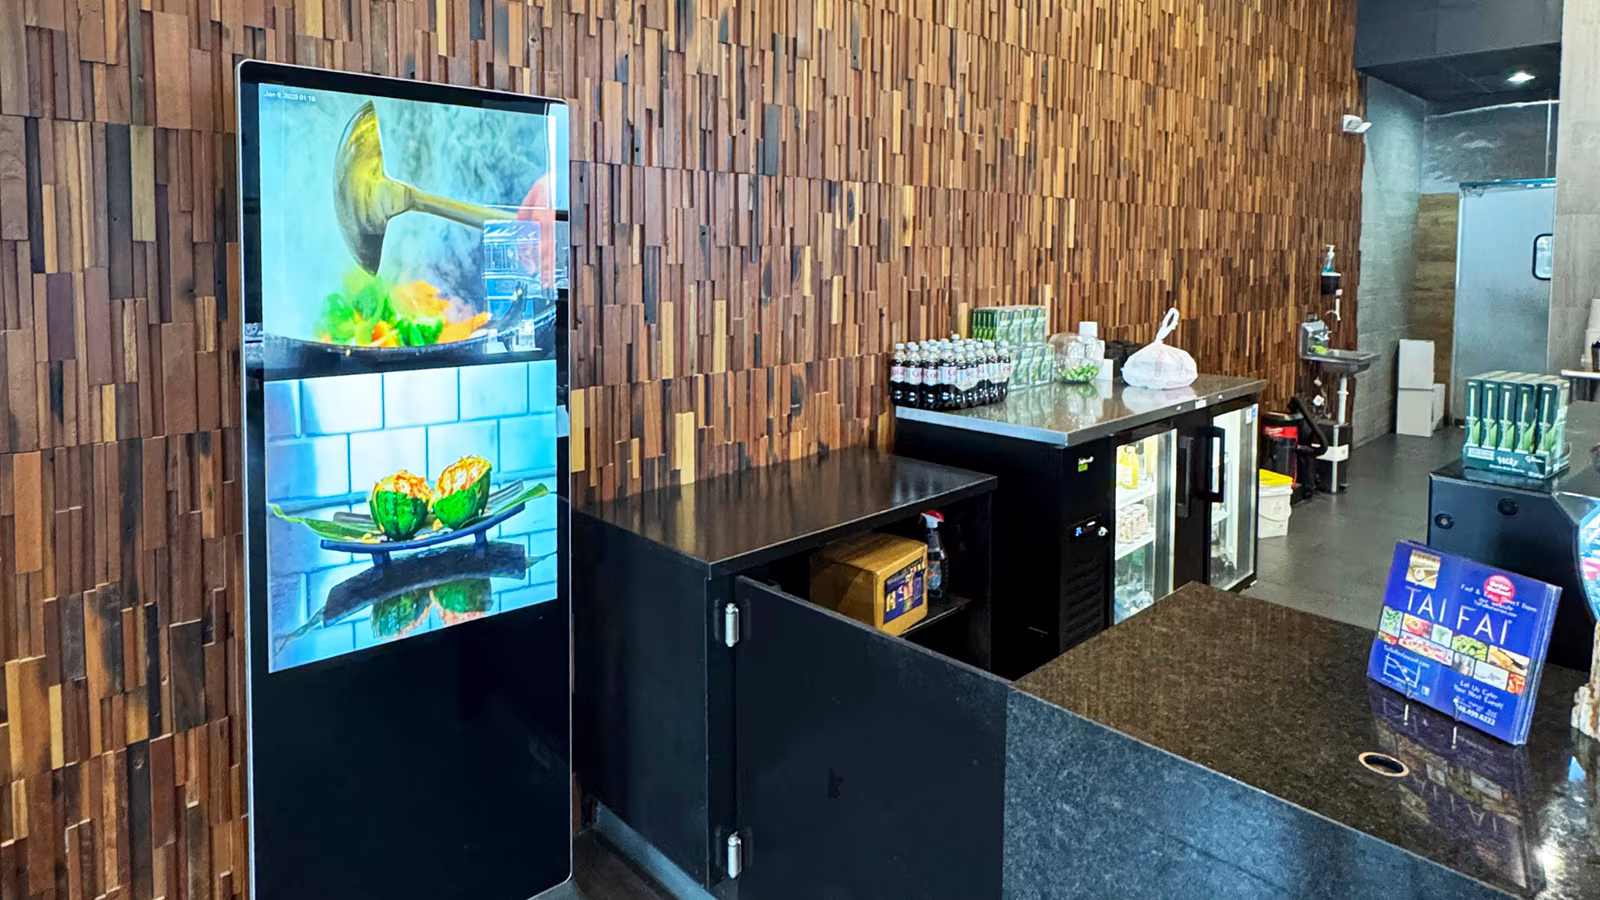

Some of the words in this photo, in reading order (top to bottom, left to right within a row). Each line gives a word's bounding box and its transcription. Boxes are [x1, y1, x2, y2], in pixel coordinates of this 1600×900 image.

[1405, 586, 1447, 623] TAI
[1457, 605, 1508, 645] FAI
[1453, 683, 1466, 694] Your
[1468, 690, 1482, 700] Next
[1460, 680, 1470, 688] Let
[1472, 684, 1480, 693] Us
[1482, 688, 1498, 700] Cater
